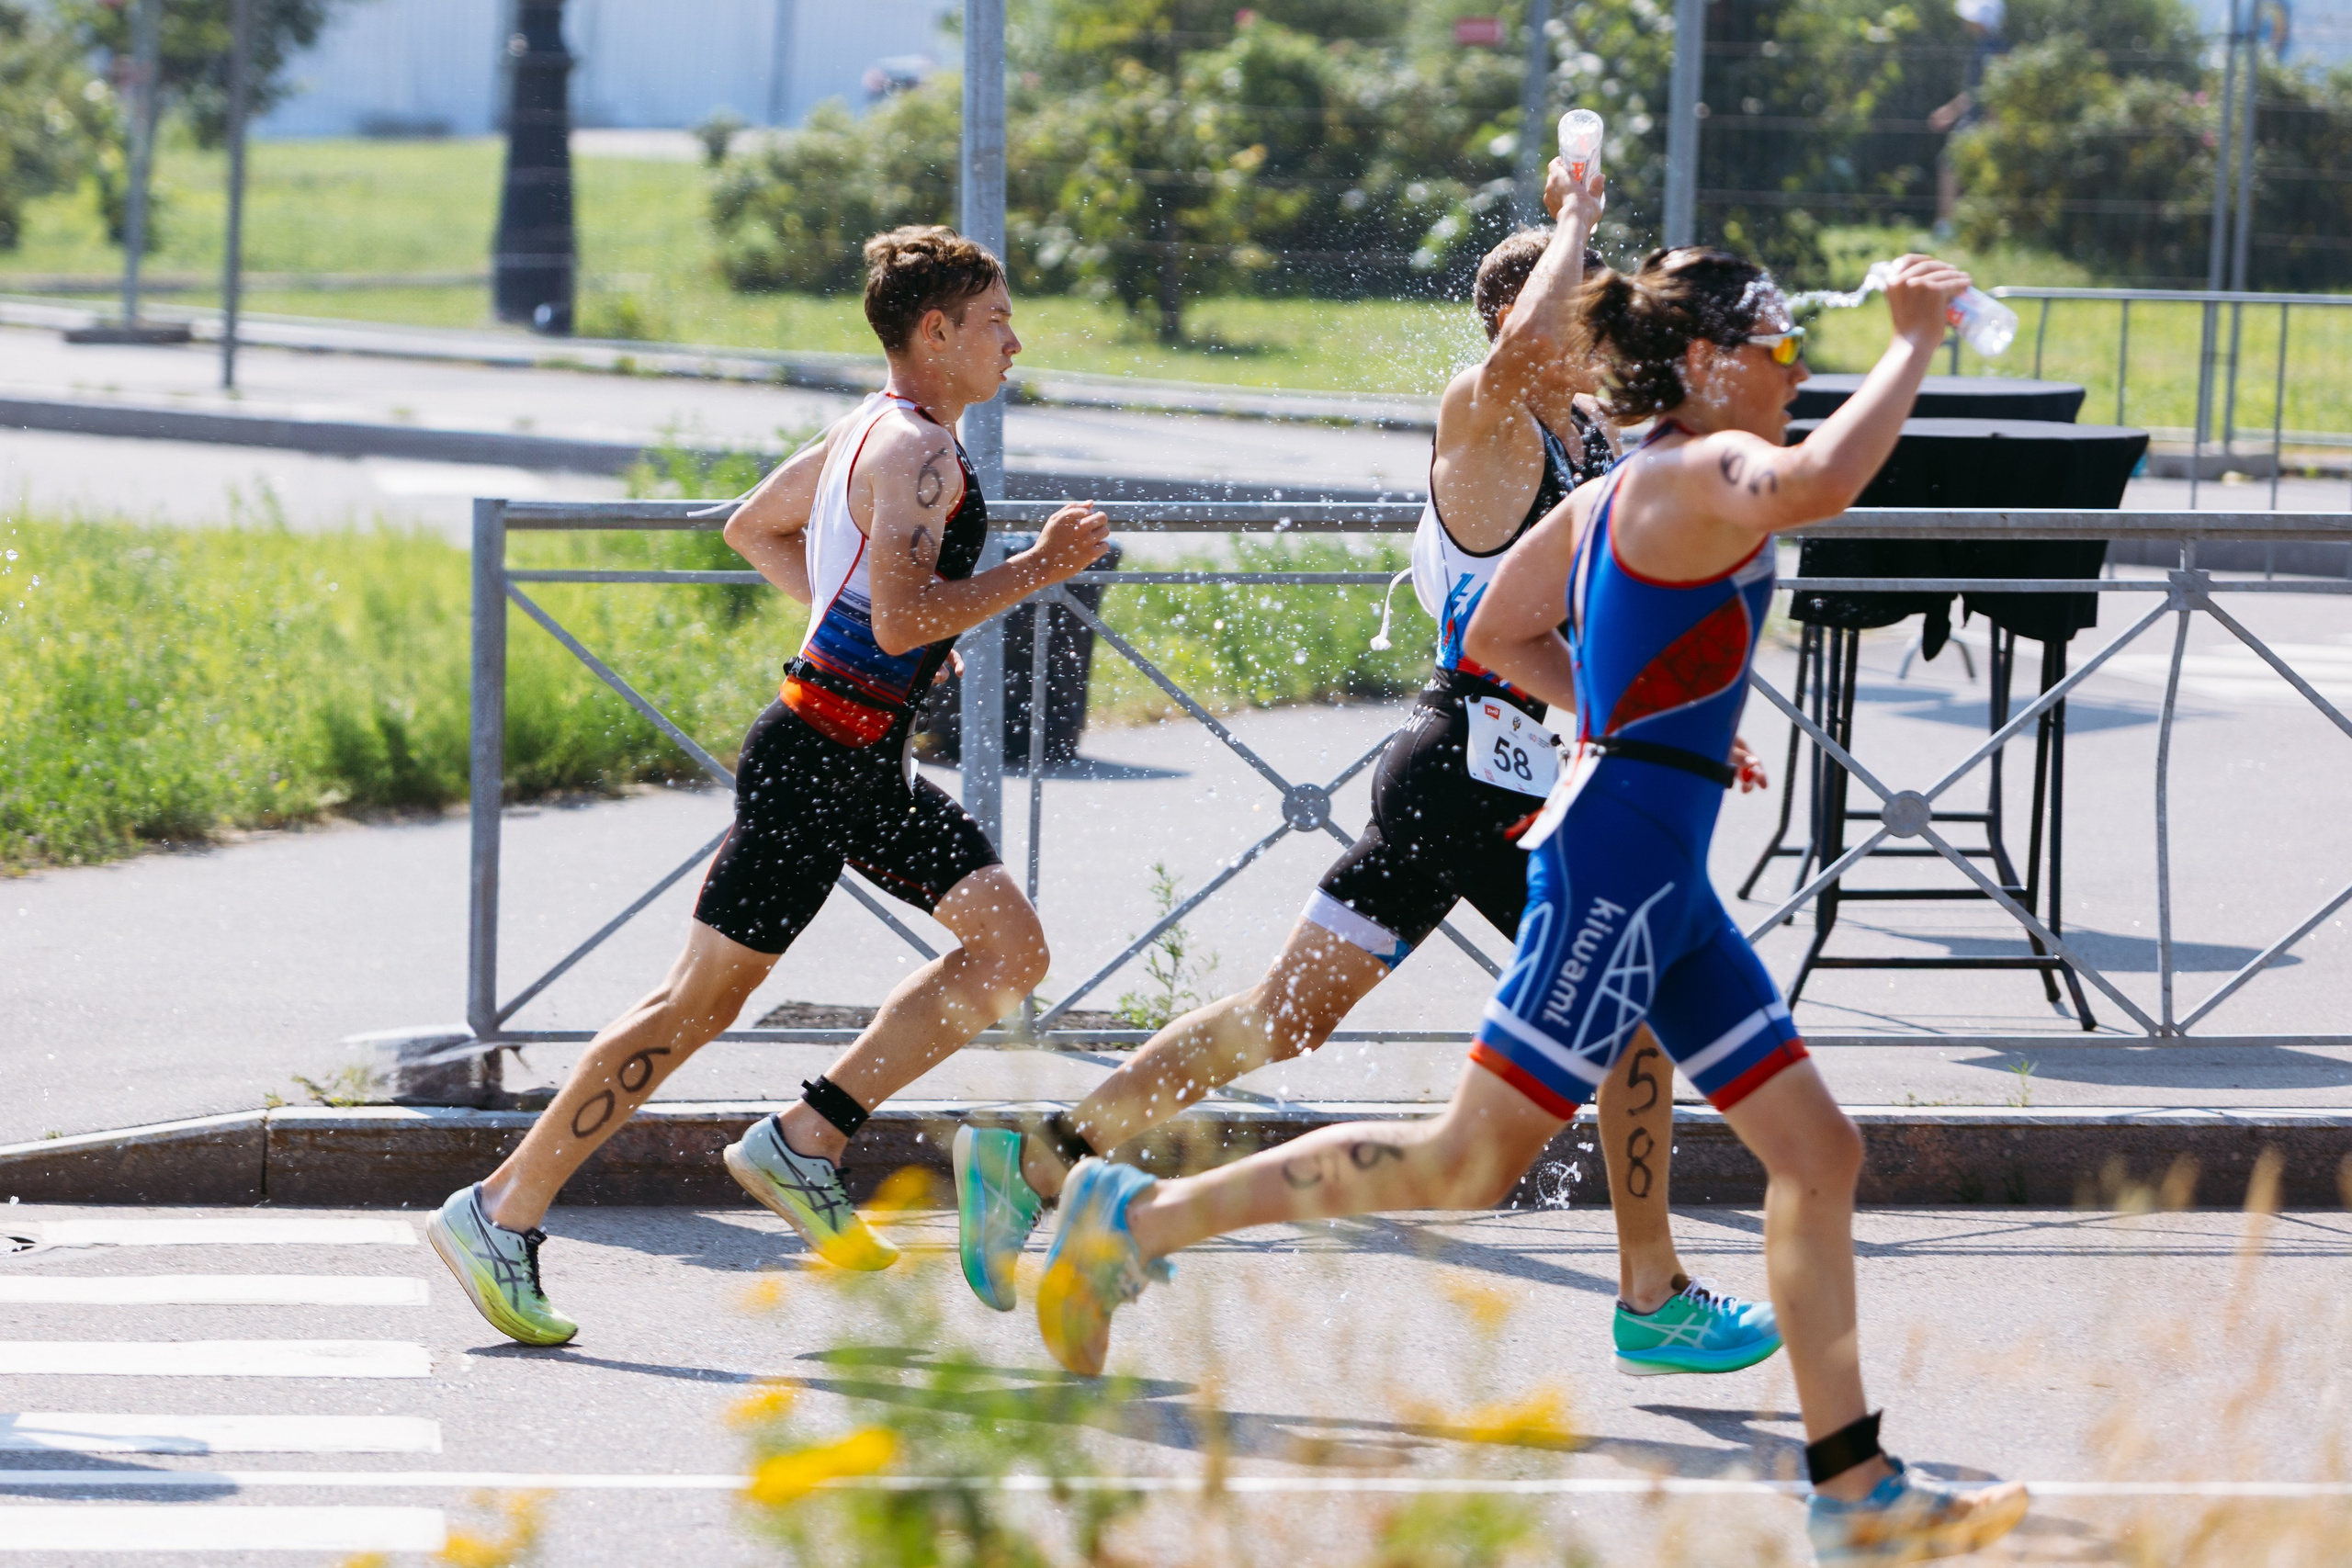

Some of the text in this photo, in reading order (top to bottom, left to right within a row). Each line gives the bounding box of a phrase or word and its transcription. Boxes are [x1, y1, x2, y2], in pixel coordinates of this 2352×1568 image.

[1493, 736, 1532, 781] 58
[1542, 897, 1626, 1028] kiwami
[571, 1046, 671, 1138] 60
[1626, 1047, 1659, 1198] 58
